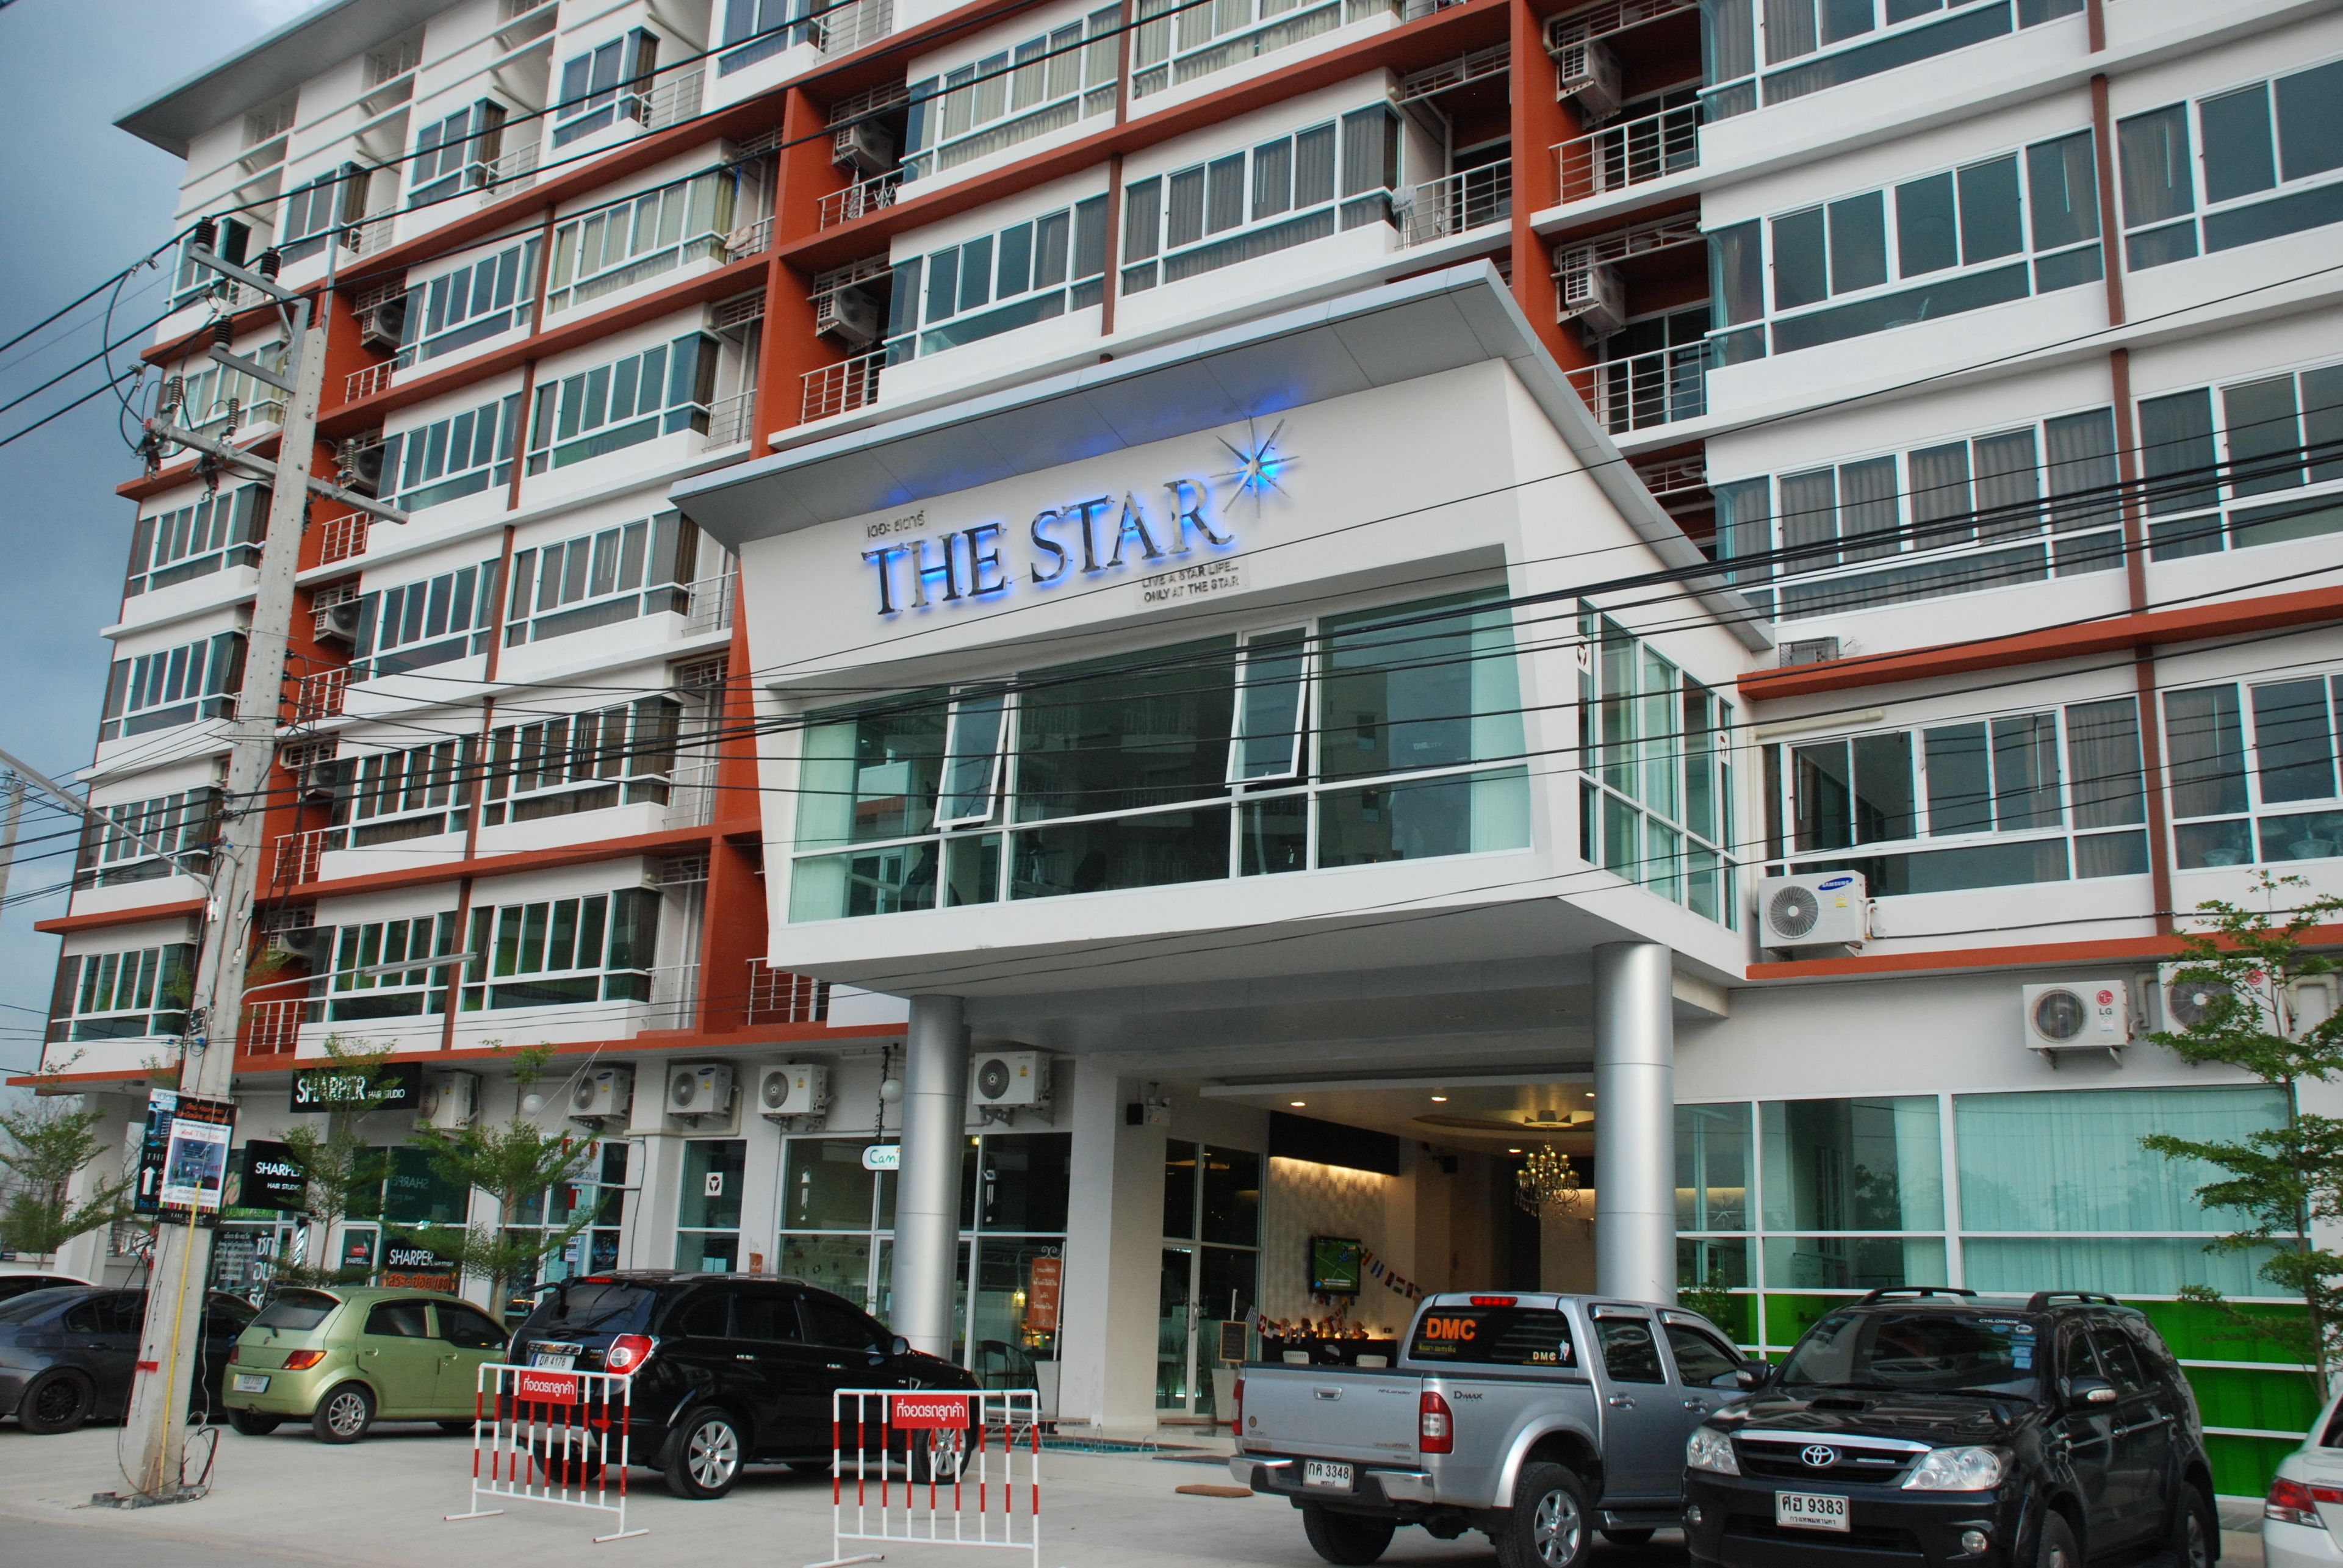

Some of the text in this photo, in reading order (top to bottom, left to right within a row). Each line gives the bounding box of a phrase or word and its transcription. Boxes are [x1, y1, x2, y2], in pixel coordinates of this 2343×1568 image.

[861, 478, 1235, 616] THE STAR
[1142, 575, 1166, 588] LIVE
[1168, 575, 1177, 584] A
[1179, 565, 1206, 580] STAR
[1144, 575, 1240, 603] ONLY AT THE STAR
[869, 1149, 900, 1163] Cam
[255, 1209, 278, 1218] SERVICE
[389, 1248, 434, 1267] SHARPER
[1427, 1318, 1476, 1340] DMC
[550, 1357, 566, 1367] 4176
[524, 1375, 574, 1397] ที่จอดรถลูกค้า
[897, 1398, 965, 1421] ที่จอดรถลูกค้า
[1326, 1465, 1349, 1479] 3348
[1808, 1498, 1843, 1515] 9383
